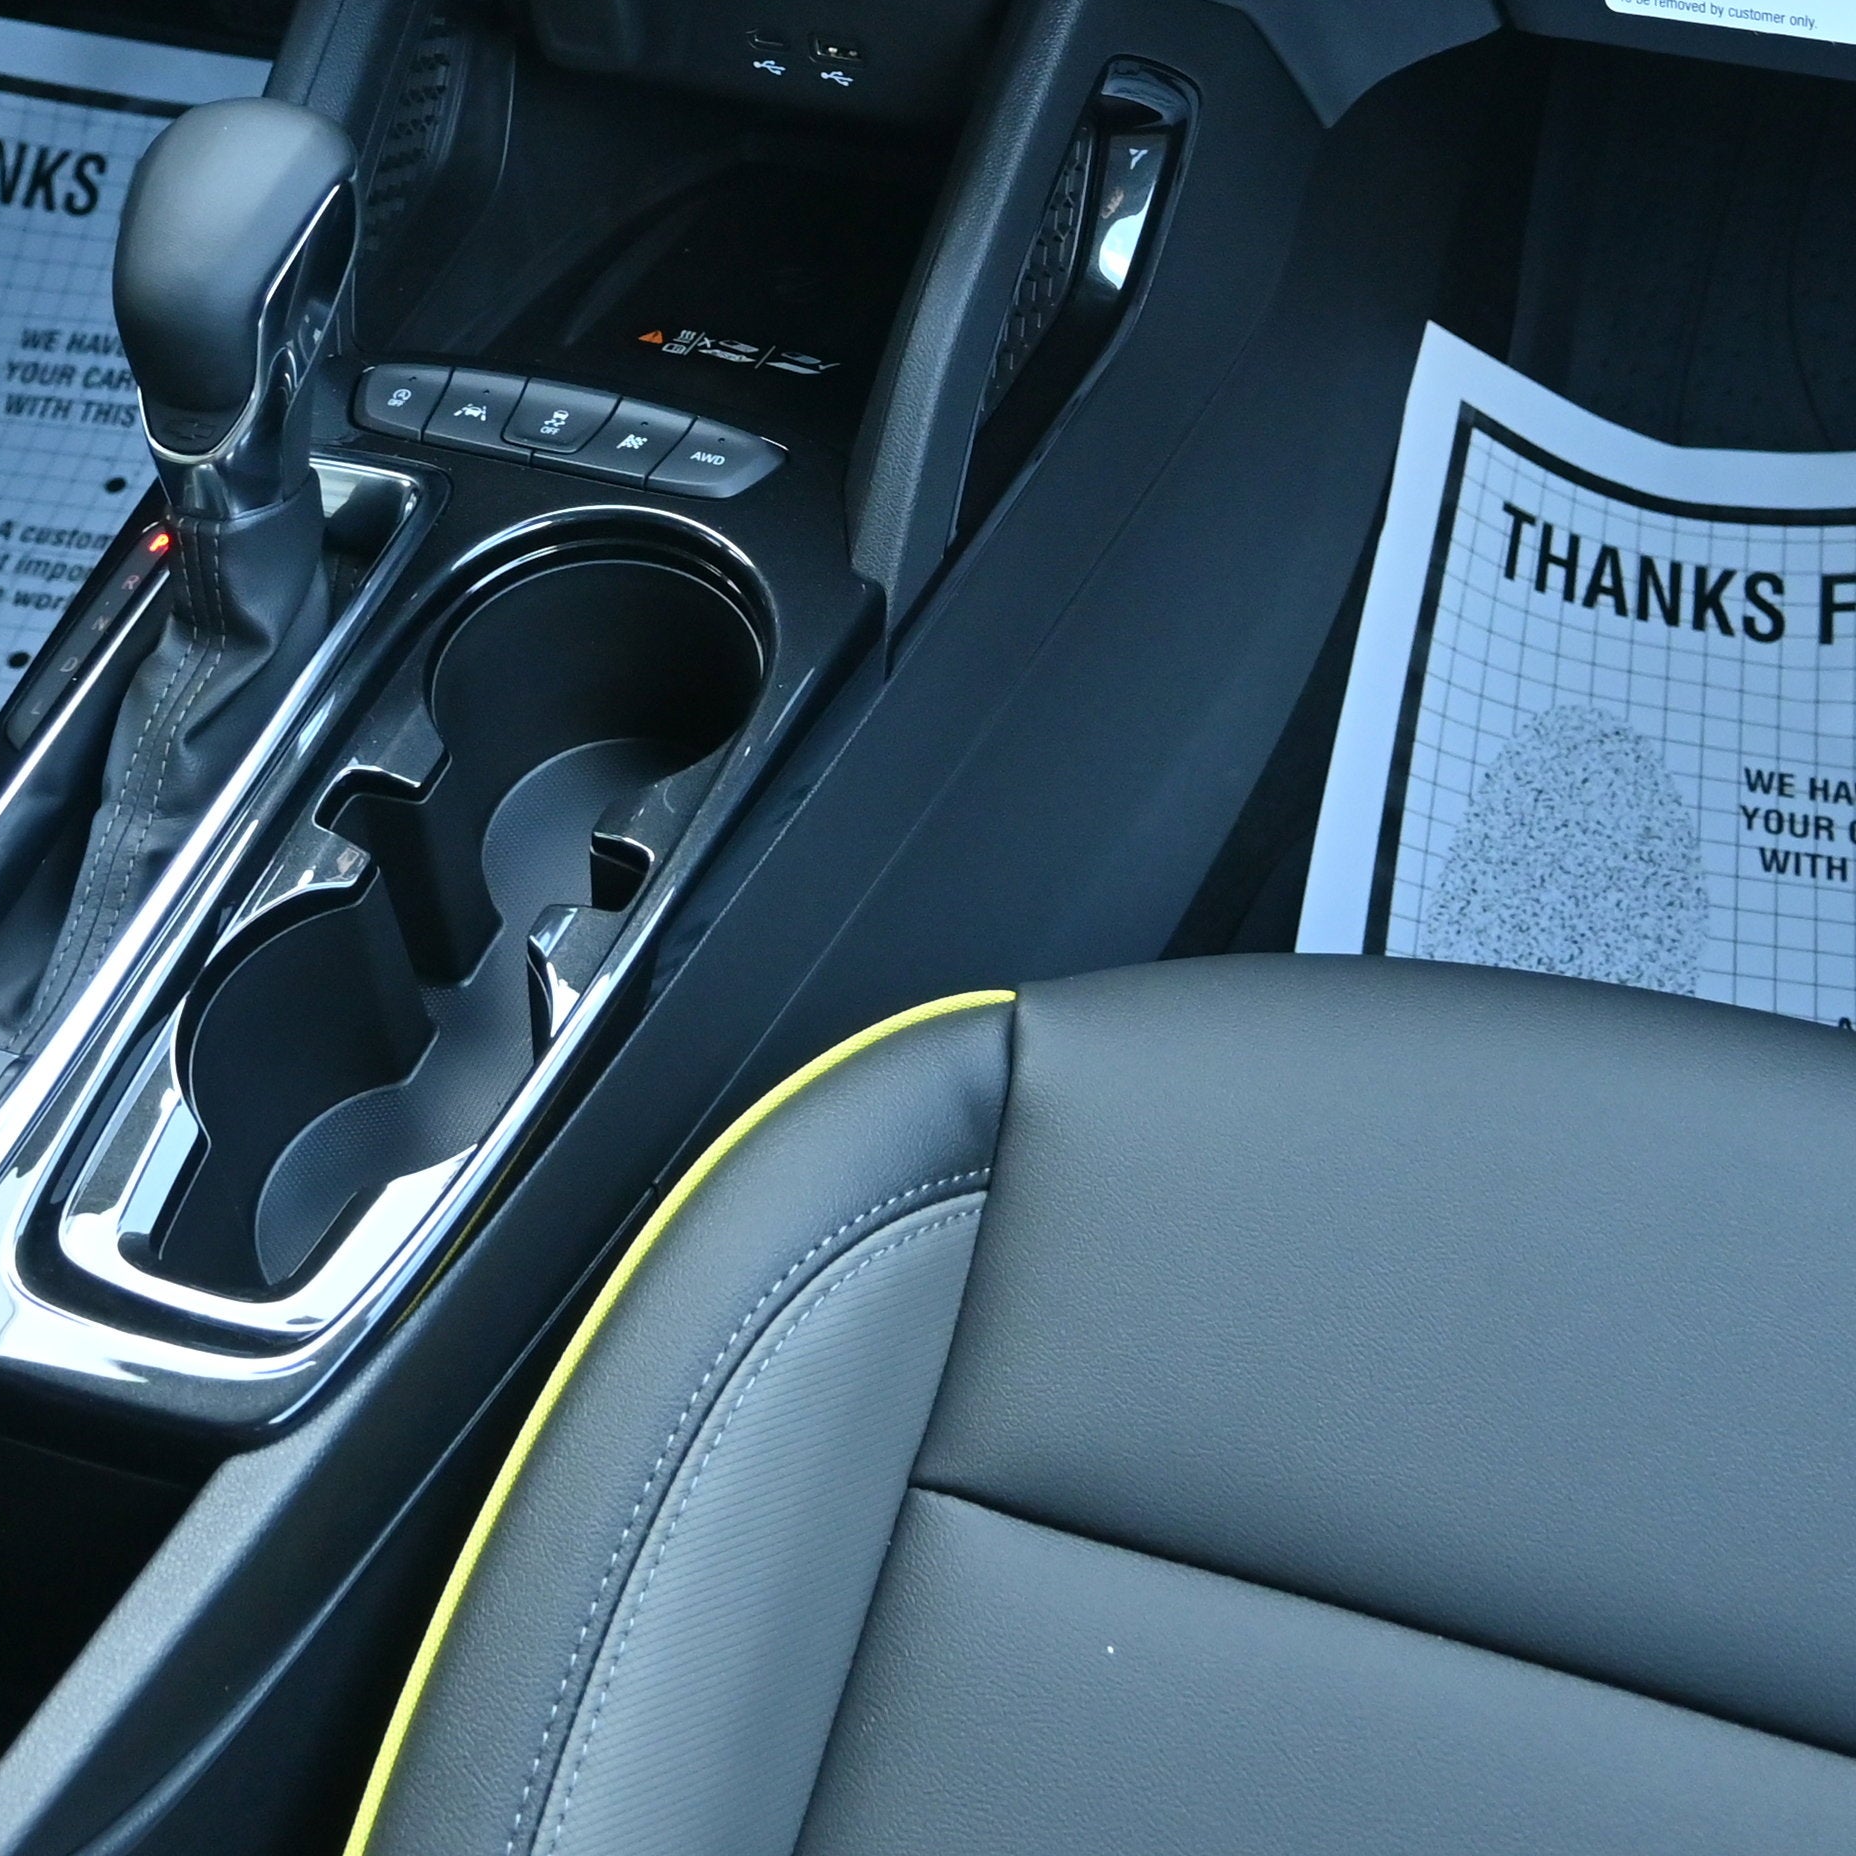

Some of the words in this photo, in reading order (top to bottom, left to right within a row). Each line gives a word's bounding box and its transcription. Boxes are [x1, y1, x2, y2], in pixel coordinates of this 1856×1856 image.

[1710, 3, 1724, 18] by
[1728, 6, 1786, 24] customer
[1789, 15, 1818, 31] only.
[20, 328, 62, 353] WE
[6, 359, 76, 387] YOUR
[5, 392, 74, 419] WITH
[80, 400, 139, 428] THIS
[539, 425, 561, 436] OFF
[689, 450, 726, 466] AWD
[148, 532, 170, 552] P
[121, 574, 140, 590] R
[1502, 500, 1787, 644] THANKS
[59, 656, 79, 673] D
[1743, 766, 1795, 798] WE
[1739, 804, 1836, 842] YOUR
[1758, 845, 1848, 883] WITH
